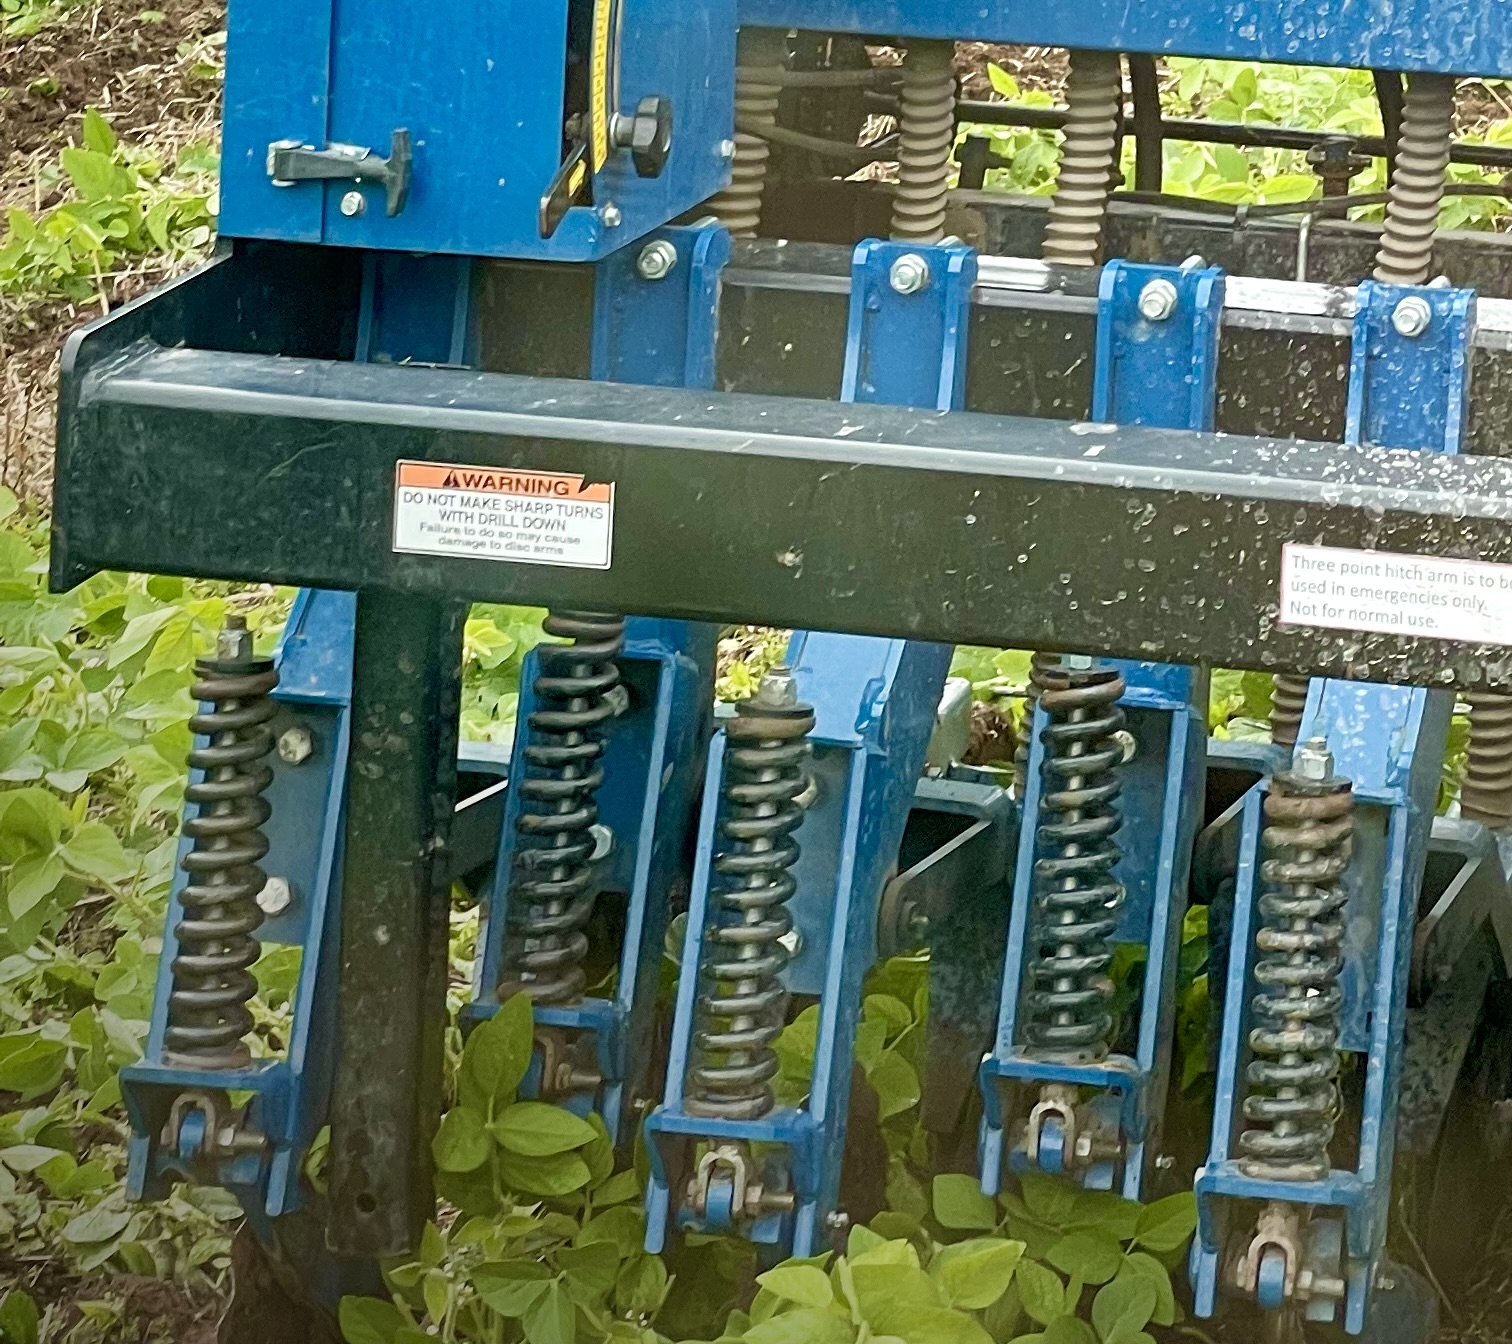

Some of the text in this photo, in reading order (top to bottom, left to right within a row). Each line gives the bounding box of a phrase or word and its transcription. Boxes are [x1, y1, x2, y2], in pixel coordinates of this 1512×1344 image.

[463, 472, 569, 496] WARNING
[404, 492, 603, 519] DO NOT MAKE SHARP TURNS
[439, 509, 566, 531] WITH DRILL DOWN
[420, 522, 581, 544] Failure to do so may cause
[439, 537, 563, 555] damage to disc arms
[1292, 555, 1335, 572] Three
[1341, 560, 1380, 575] point
[1385, 563, 1422, 581] hitch
[1428, 571, 1457, 585] arm
[1463, 573, 1475, 586] is
[1480, 575, 1494, 587] to
[1291, 579, 1487, 613] used in emergencies only.
[1290, 601, 1438, 628] Not for normal use.
